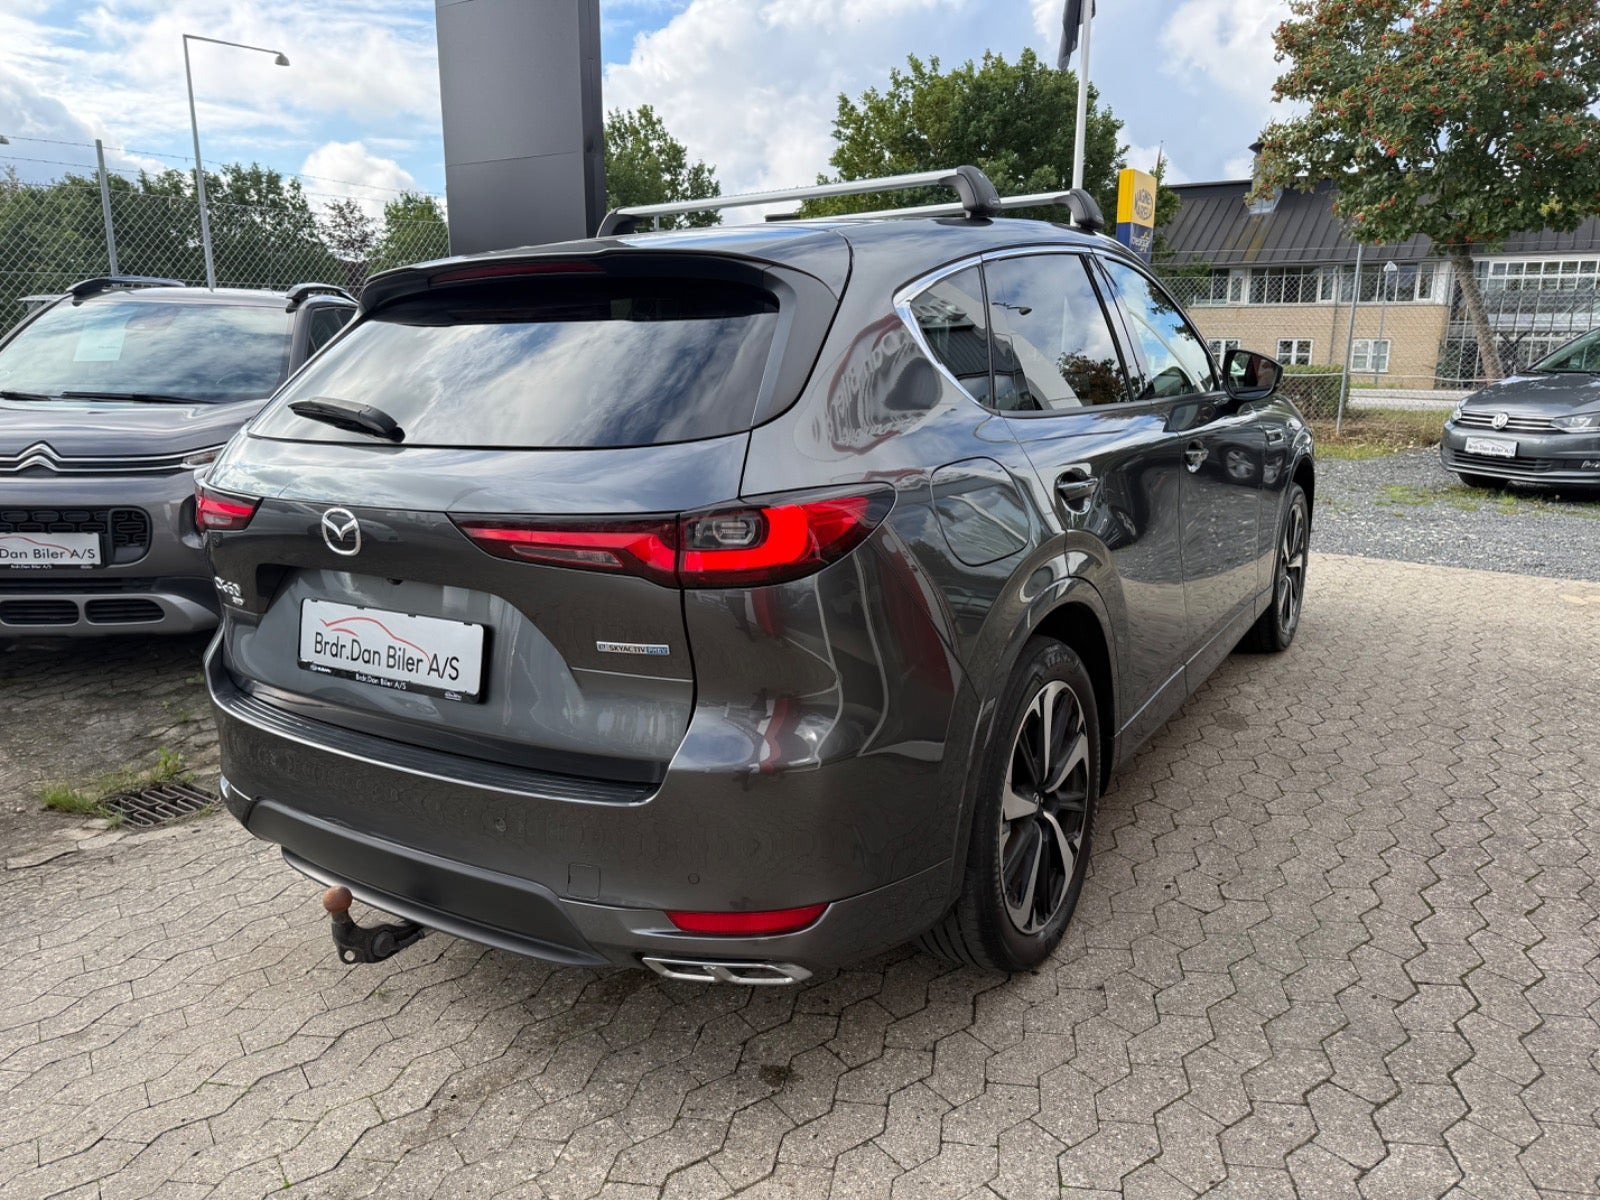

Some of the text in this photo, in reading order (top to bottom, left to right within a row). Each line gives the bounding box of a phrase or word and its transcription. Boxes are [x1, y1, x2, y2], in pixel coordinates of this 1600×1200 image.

[0, 547, 96, 560] Dan Biler A/S
[608, 644, 646, 653] SKYACTIV
[314, 631, 460, 681] Brdr.Dan Biler A/S
